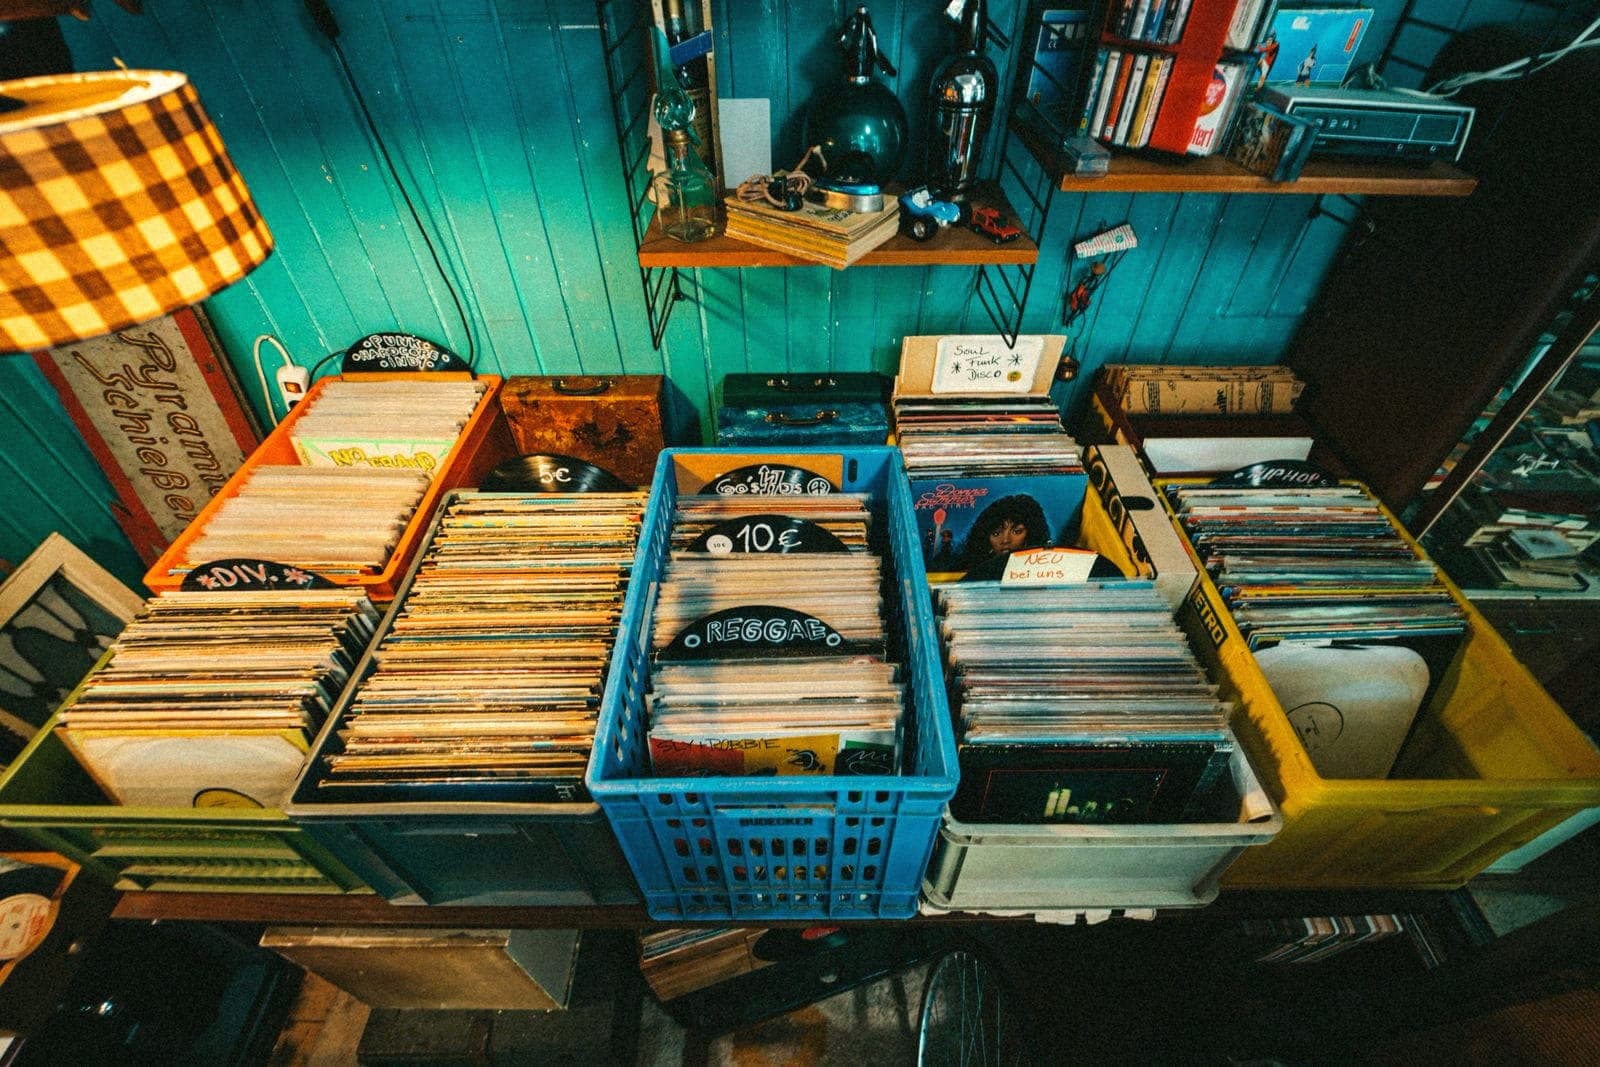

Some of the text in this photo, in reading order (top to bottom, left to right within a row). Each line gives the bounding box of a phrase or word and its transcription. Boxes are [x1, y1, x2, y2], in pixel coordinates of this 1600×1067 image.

[369, 334, 421, 350] PUNK
[538, 463, 572, 484] 5€
[1024, 553, 1063, 565] NEU
[1010, 570, 1064, 579] bei uns
[1192, 588, 1225, 645] ETRO
[706, 617, 826, 643] REGGAE
